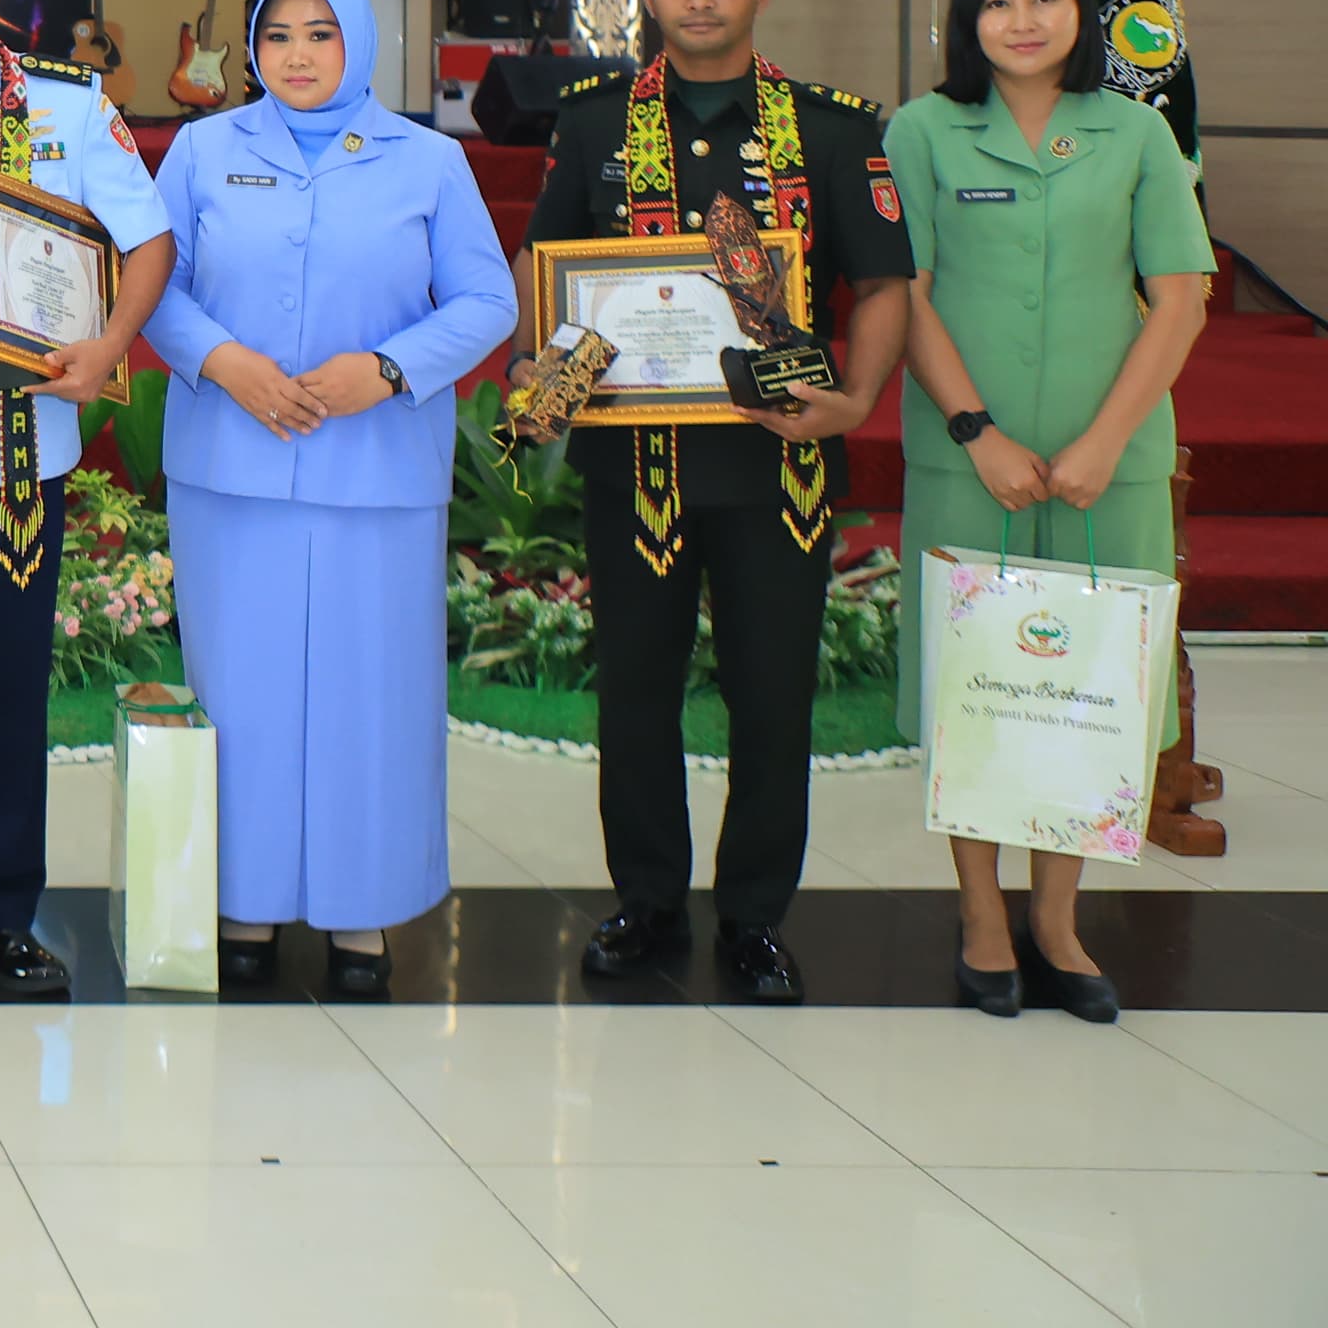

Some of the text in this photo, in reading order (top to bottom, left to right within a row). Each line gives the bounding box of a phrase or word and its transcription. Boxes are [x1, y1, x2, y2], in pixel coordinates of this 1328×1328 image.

[966, 671, 1117, 708] Semoga Berkenan
[1062, 716, 1122, 737] Pramono
